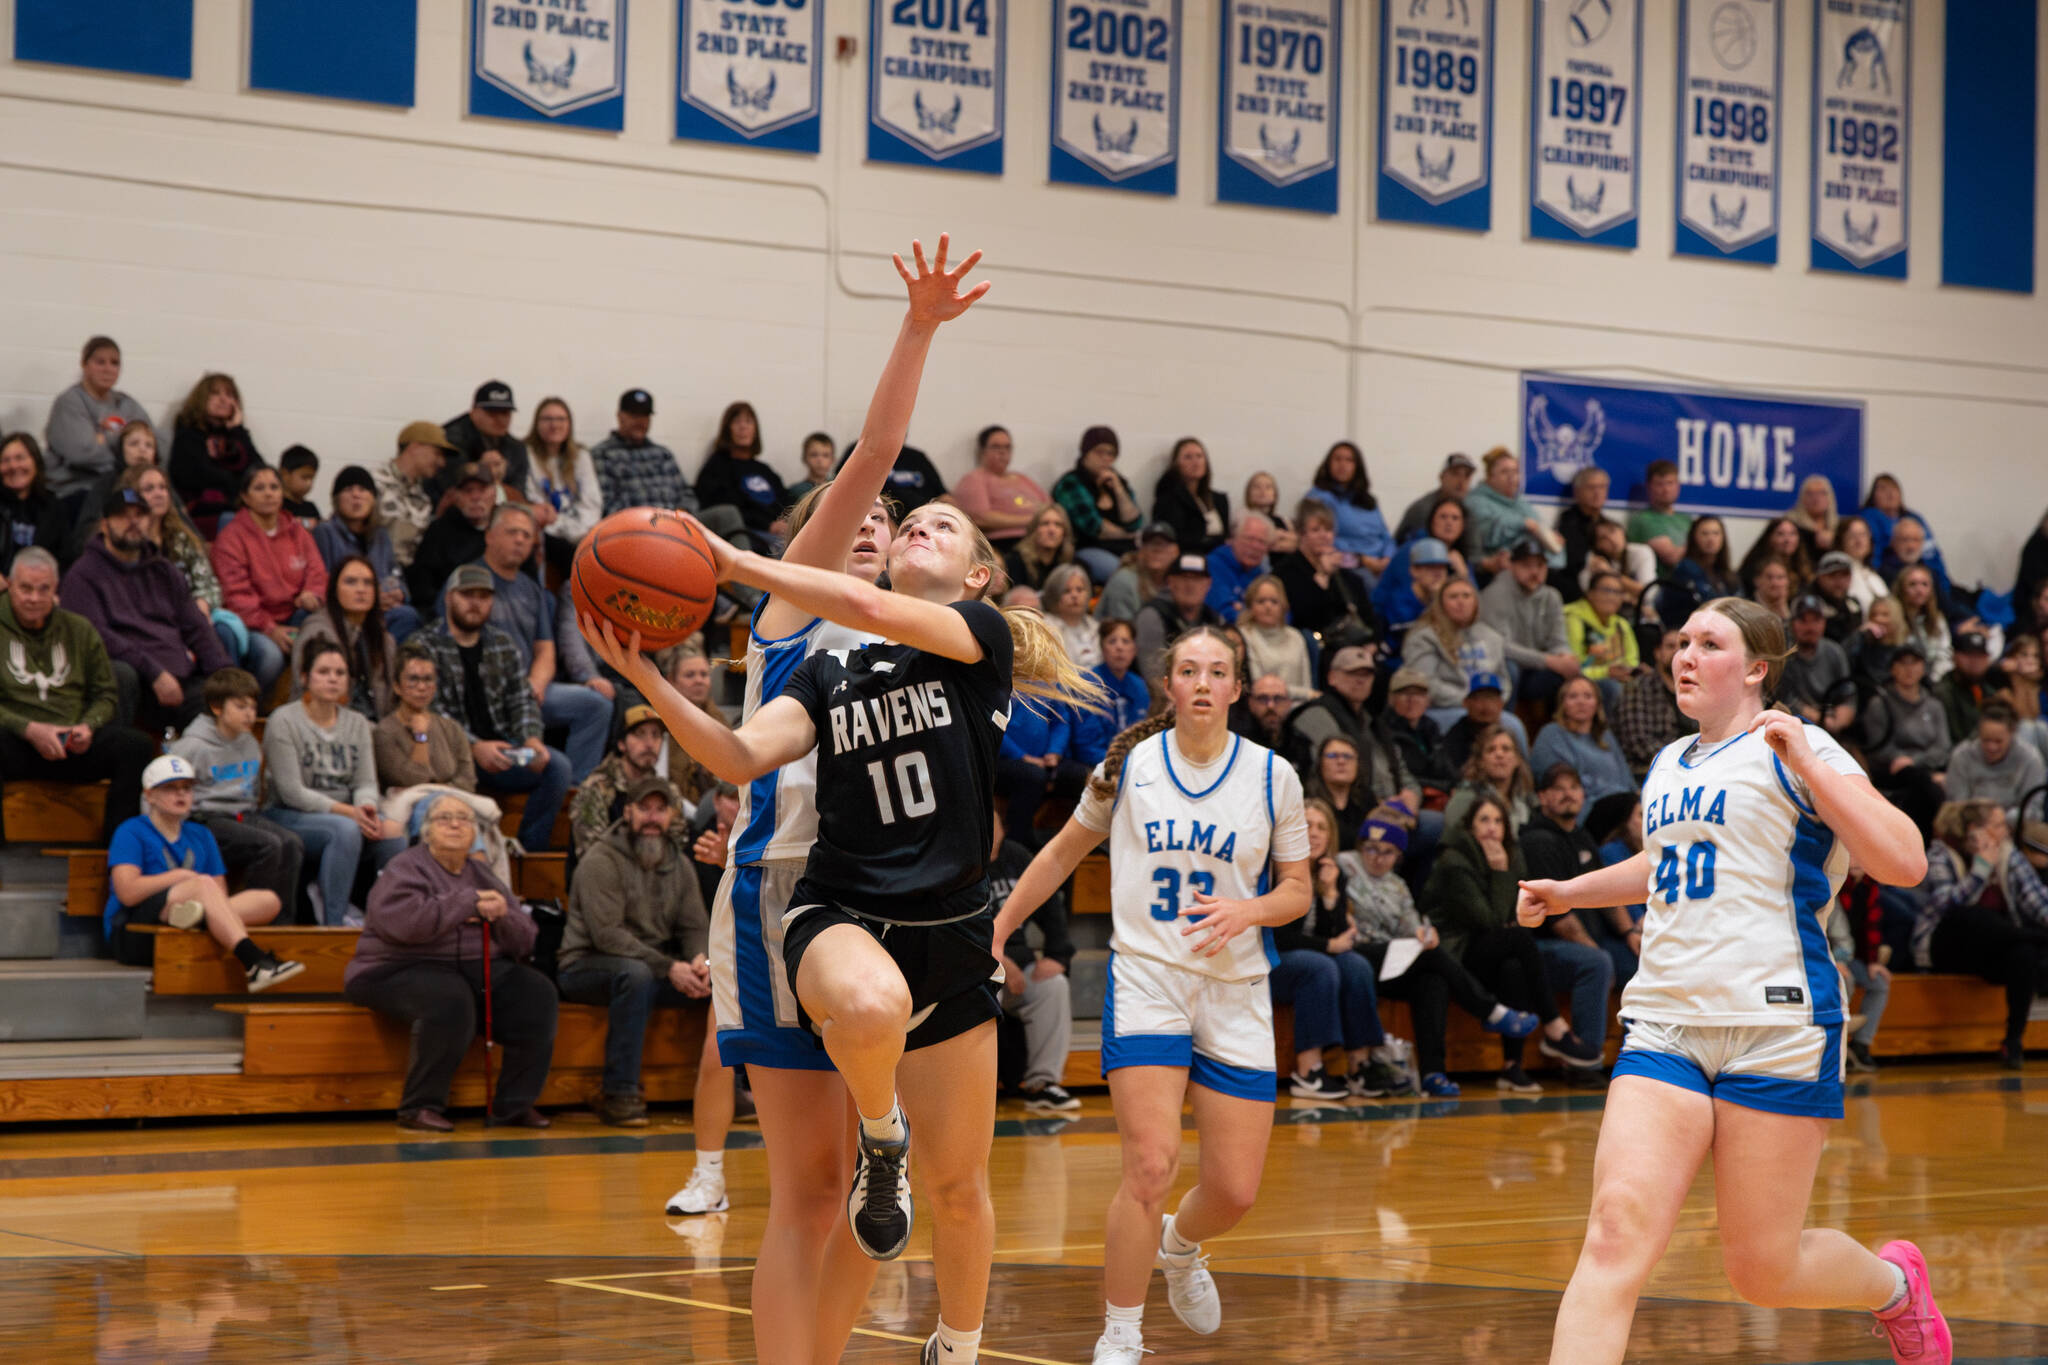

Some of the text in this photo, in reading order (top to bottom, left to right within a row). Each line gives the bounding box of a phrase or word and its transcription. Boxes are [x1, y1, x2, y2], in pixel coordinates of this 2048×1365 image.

[493, 5, 538, 30] 2ND
[546, 13, 609, 41] PLACE
[721, 10, 786, 37] STATE
[892, 0, 988, 36] 2014
[1068, 5, 1168, 62] 2002
[697, 32, 806, 64] 2ND PLACE
[910, 36, 970, 61] STATE
[1240, 23, 1323, 75] 1970
[885, 57, 991, 88] CHAMPIONS
[1090, 61, 1146, 86] STATE
[1257, 74, 1308, 98] STATE
[1397, 46, 1477, 95] 1989
[1068, 82, 1164, 112] 2ND PLACE
[1237, 93, 1324, 122] 2ND PLACE
[1413, 96, 1461, 118] STATE
[1550, 77, 1627, 125] 1997
[1395, 114, 1477, 140] 2ND PLACE
[1694, 97, 1768, 143] 1998
[1565, 128, 1612, 150] STATE
[1828, 116, 1897, 163] 1992
[1544, 147, 1630, 172] CHAMPIONS
[1709, 147, 1753, 167] STATE
[1690, 164, 1771, 189] CHAMPIONS
[1842, 165, 1884, 184] STATE
[1826, 181, 1897, 206] 2ND PLACE
[1677, 418, 1795, 492] HOME
[829, 680, 952, 756] RAVENS
[867, 750, 937, 826] 10
[1647, 786, 1727, 837] ELMA
[1145, 819, 1237, 864] ELMA
[1655, 840, 1717, 905] 40
